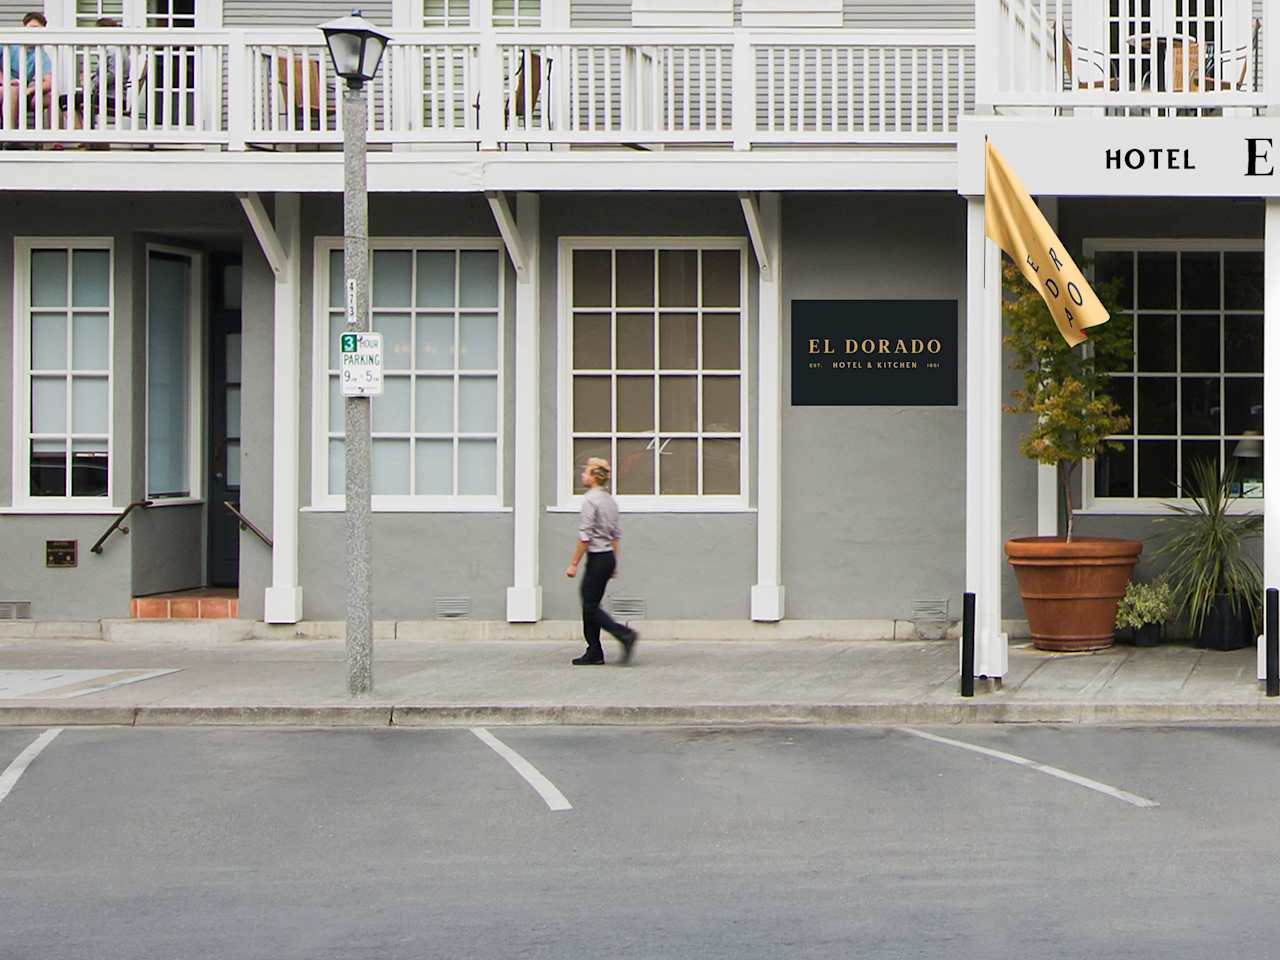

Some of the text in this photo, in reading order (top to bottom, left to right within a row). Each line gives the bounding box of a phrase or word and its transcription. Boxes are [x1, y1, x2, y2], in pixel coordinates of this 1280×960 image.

[1105, 148, 1196, 170] HOTEL
[343, 337, 353, 352] 3
[808, 338, 941, 354] EL DORADO
[343, 354, 380, 366] PARKING
[832, 361, 863, 369] HOTEL
[867, 361, 873, 369] &
[877, 361, 917, 369] KITCHEN
